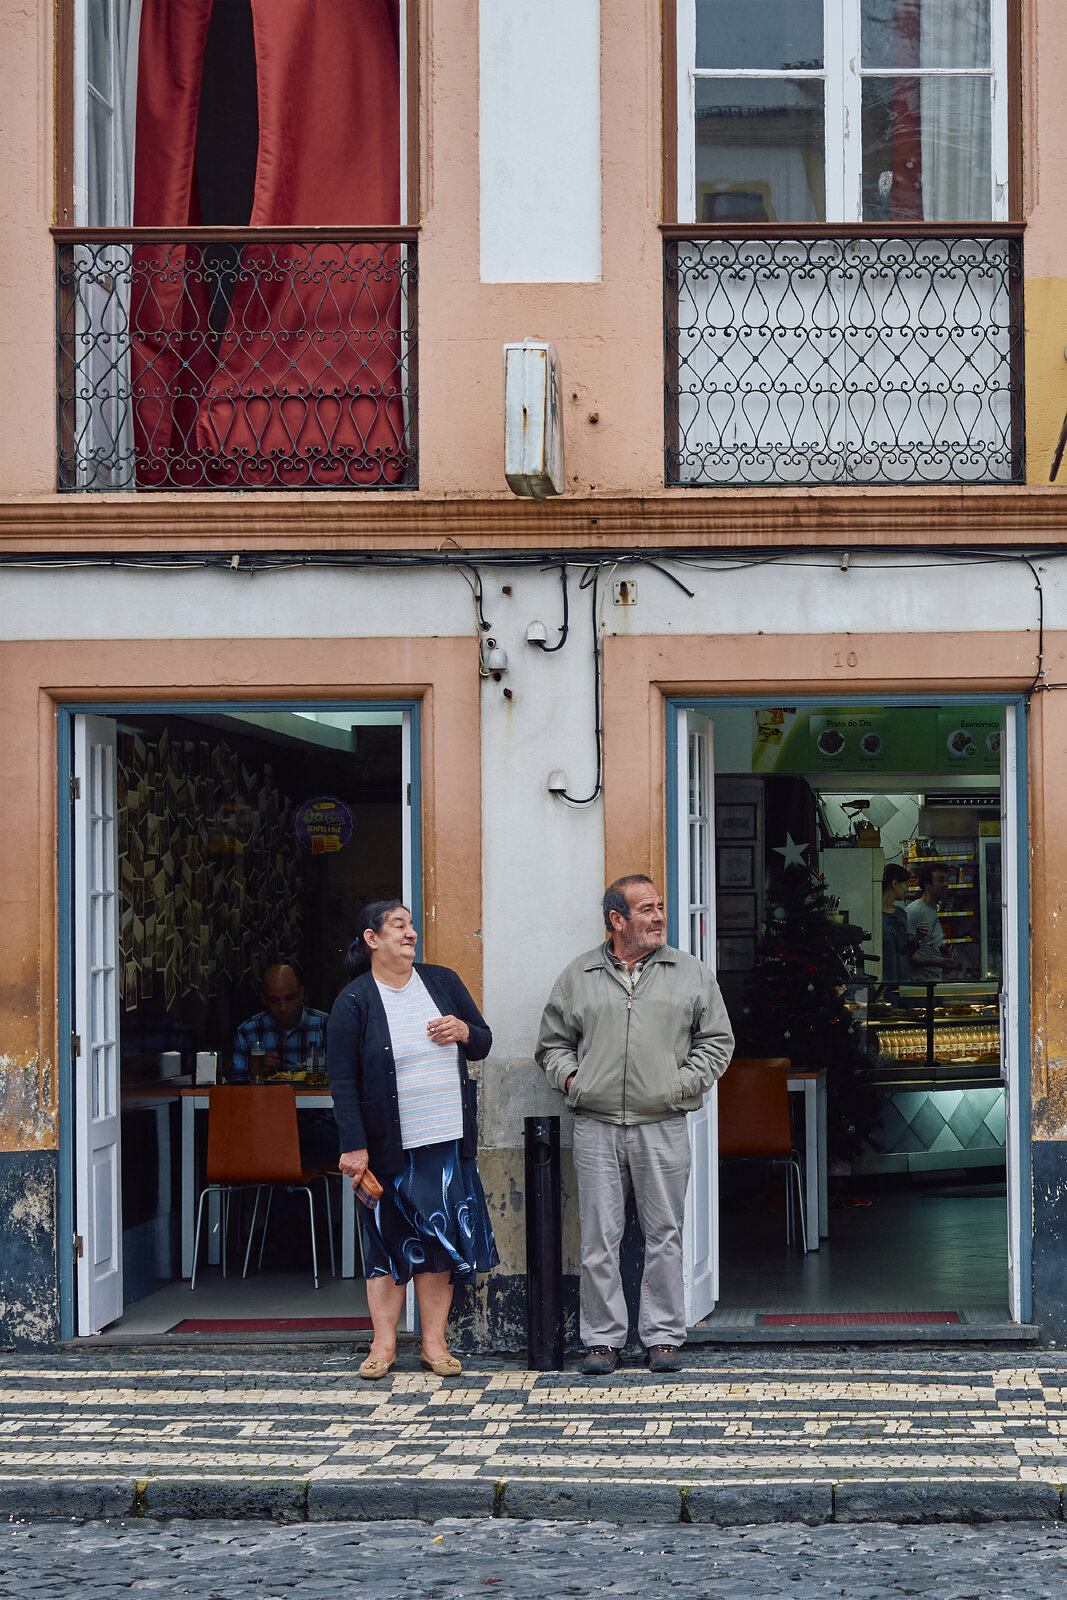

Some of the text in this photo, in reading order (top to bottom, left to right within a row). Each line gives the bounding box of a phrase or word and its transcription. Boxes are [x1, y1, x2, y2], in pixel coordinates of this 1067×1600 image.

[833, 651, 858, 668] 10
[826, 720, 872, 728] Prato do Dia
[960, 720, 1000, 728] Económico
